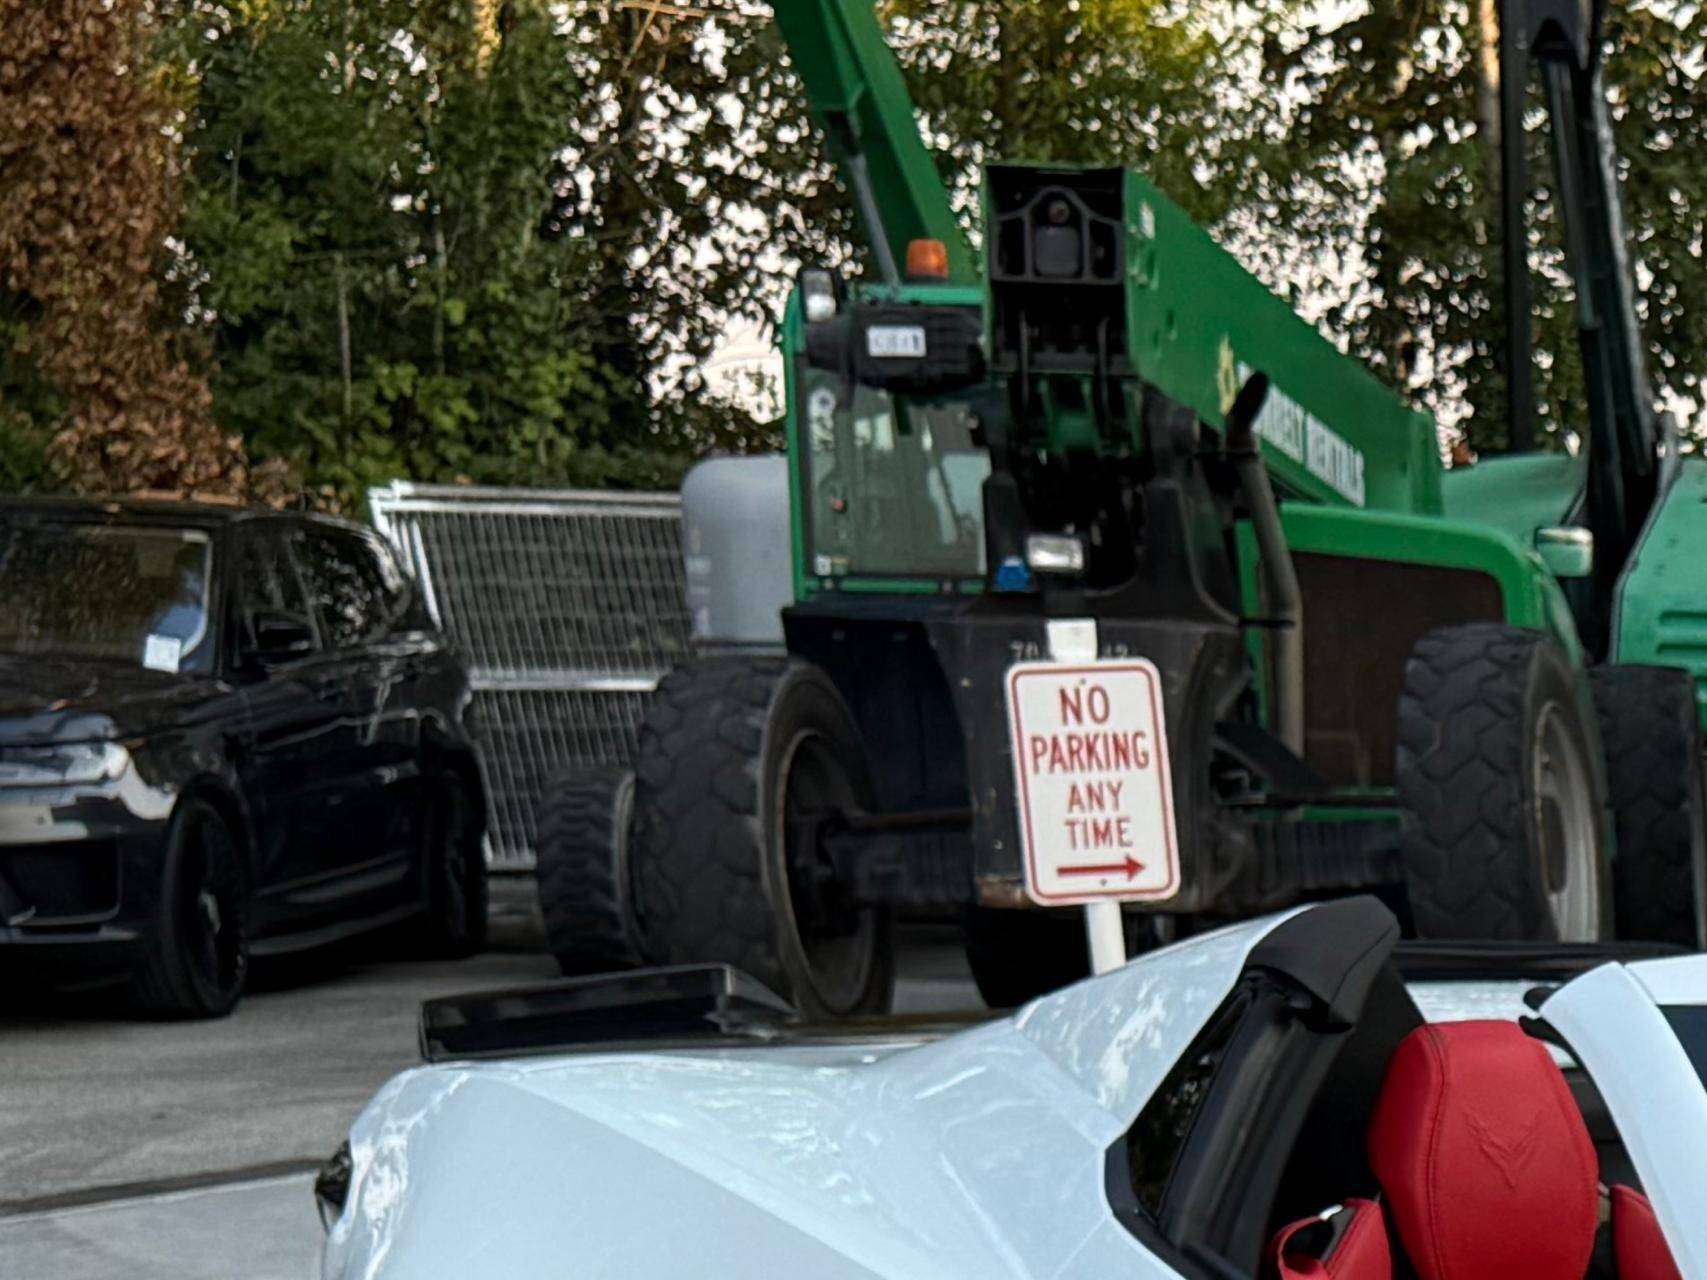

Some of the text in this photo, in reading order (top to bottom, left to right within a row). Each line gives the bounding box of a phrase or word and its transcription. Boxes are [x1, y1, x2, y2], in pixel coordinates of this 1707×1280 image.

[1059, 684, 1110, 726] NO
[1030, 731, 1150, 775] PARKING
[1067, 780, 1123, 814] ANY
[1065, 816, 1133, 850] TIME
